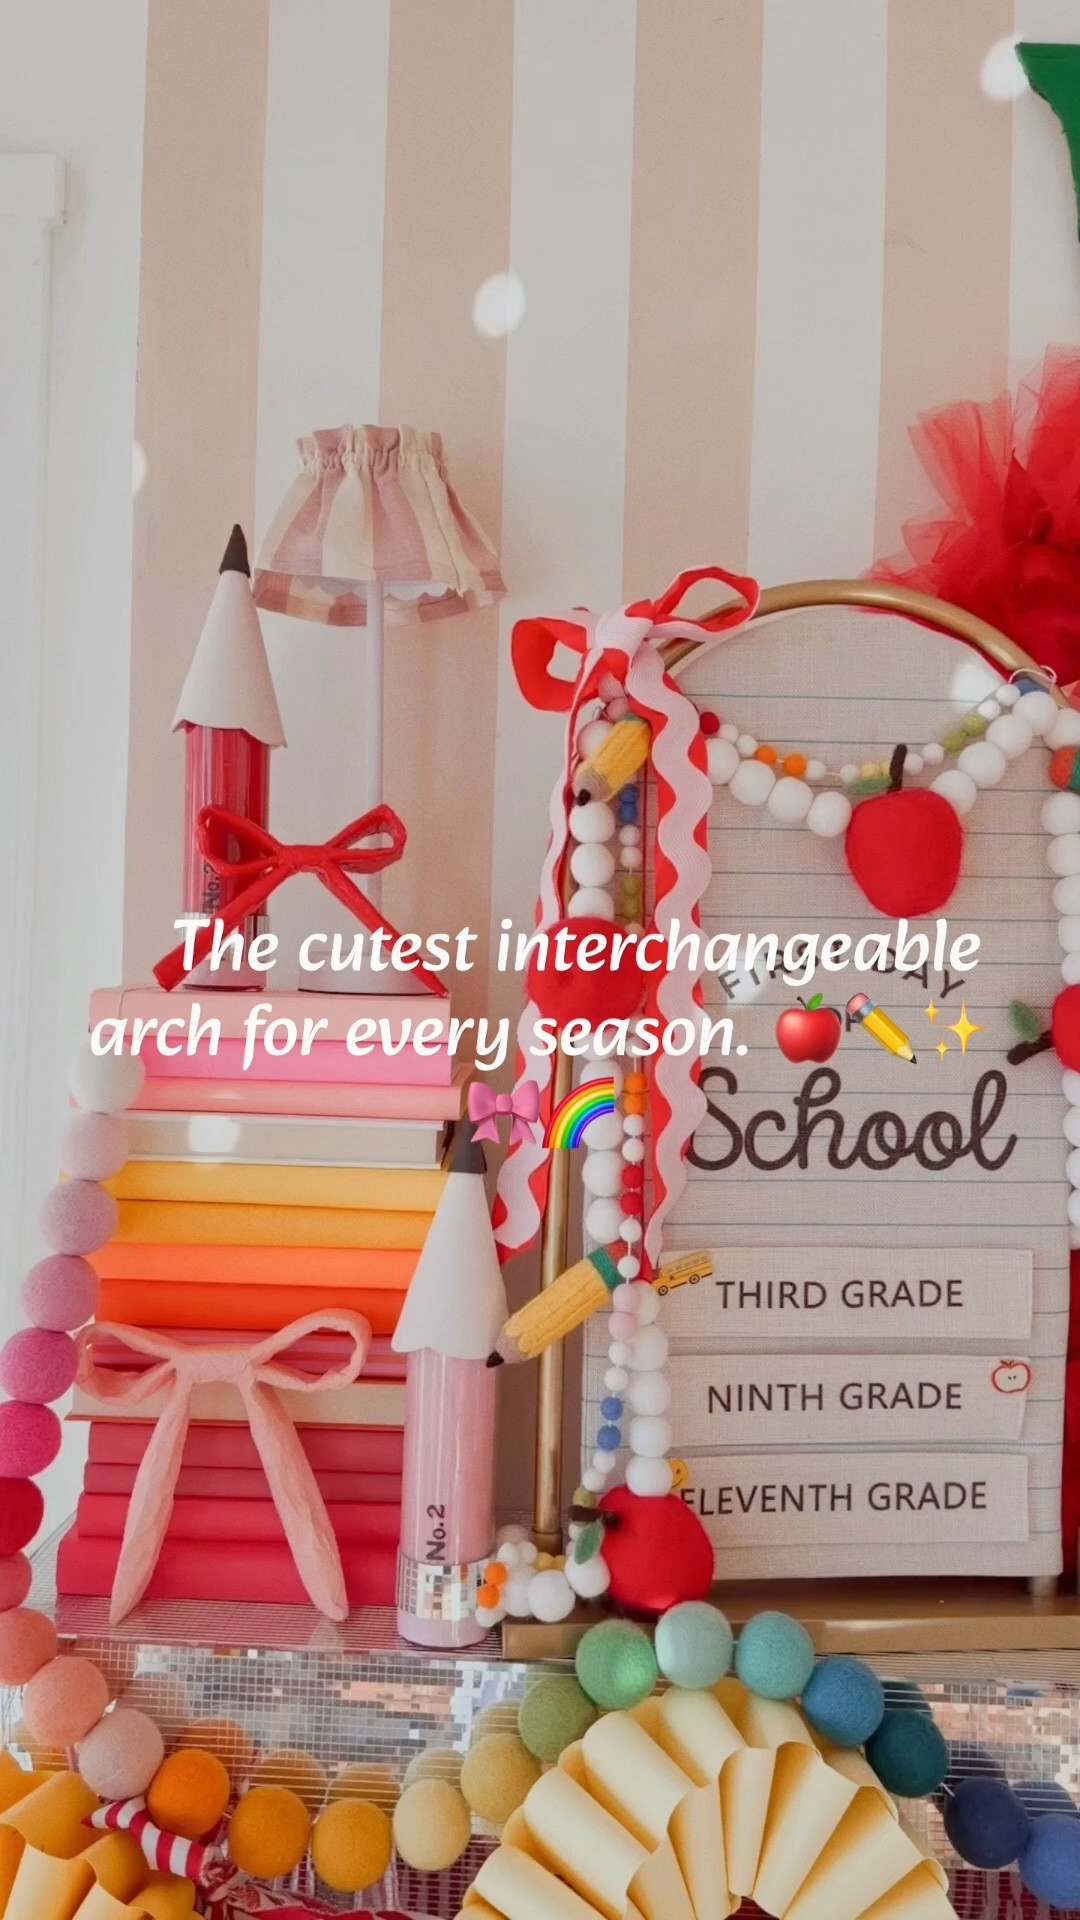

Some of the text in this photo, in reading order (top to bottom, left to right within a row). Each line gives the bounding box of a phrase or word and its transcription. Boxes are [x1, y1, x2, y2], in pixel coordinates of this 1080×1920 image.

[685, 1066, 1018, 1172] School
[715, 1279, 964, 1309] THIRD GRADE
[707, 1382, 963, 1414] NINTH GRADE
[867, 1481, 988, 1512] GRADE
[426, 1503, 446, 1562] No.2
